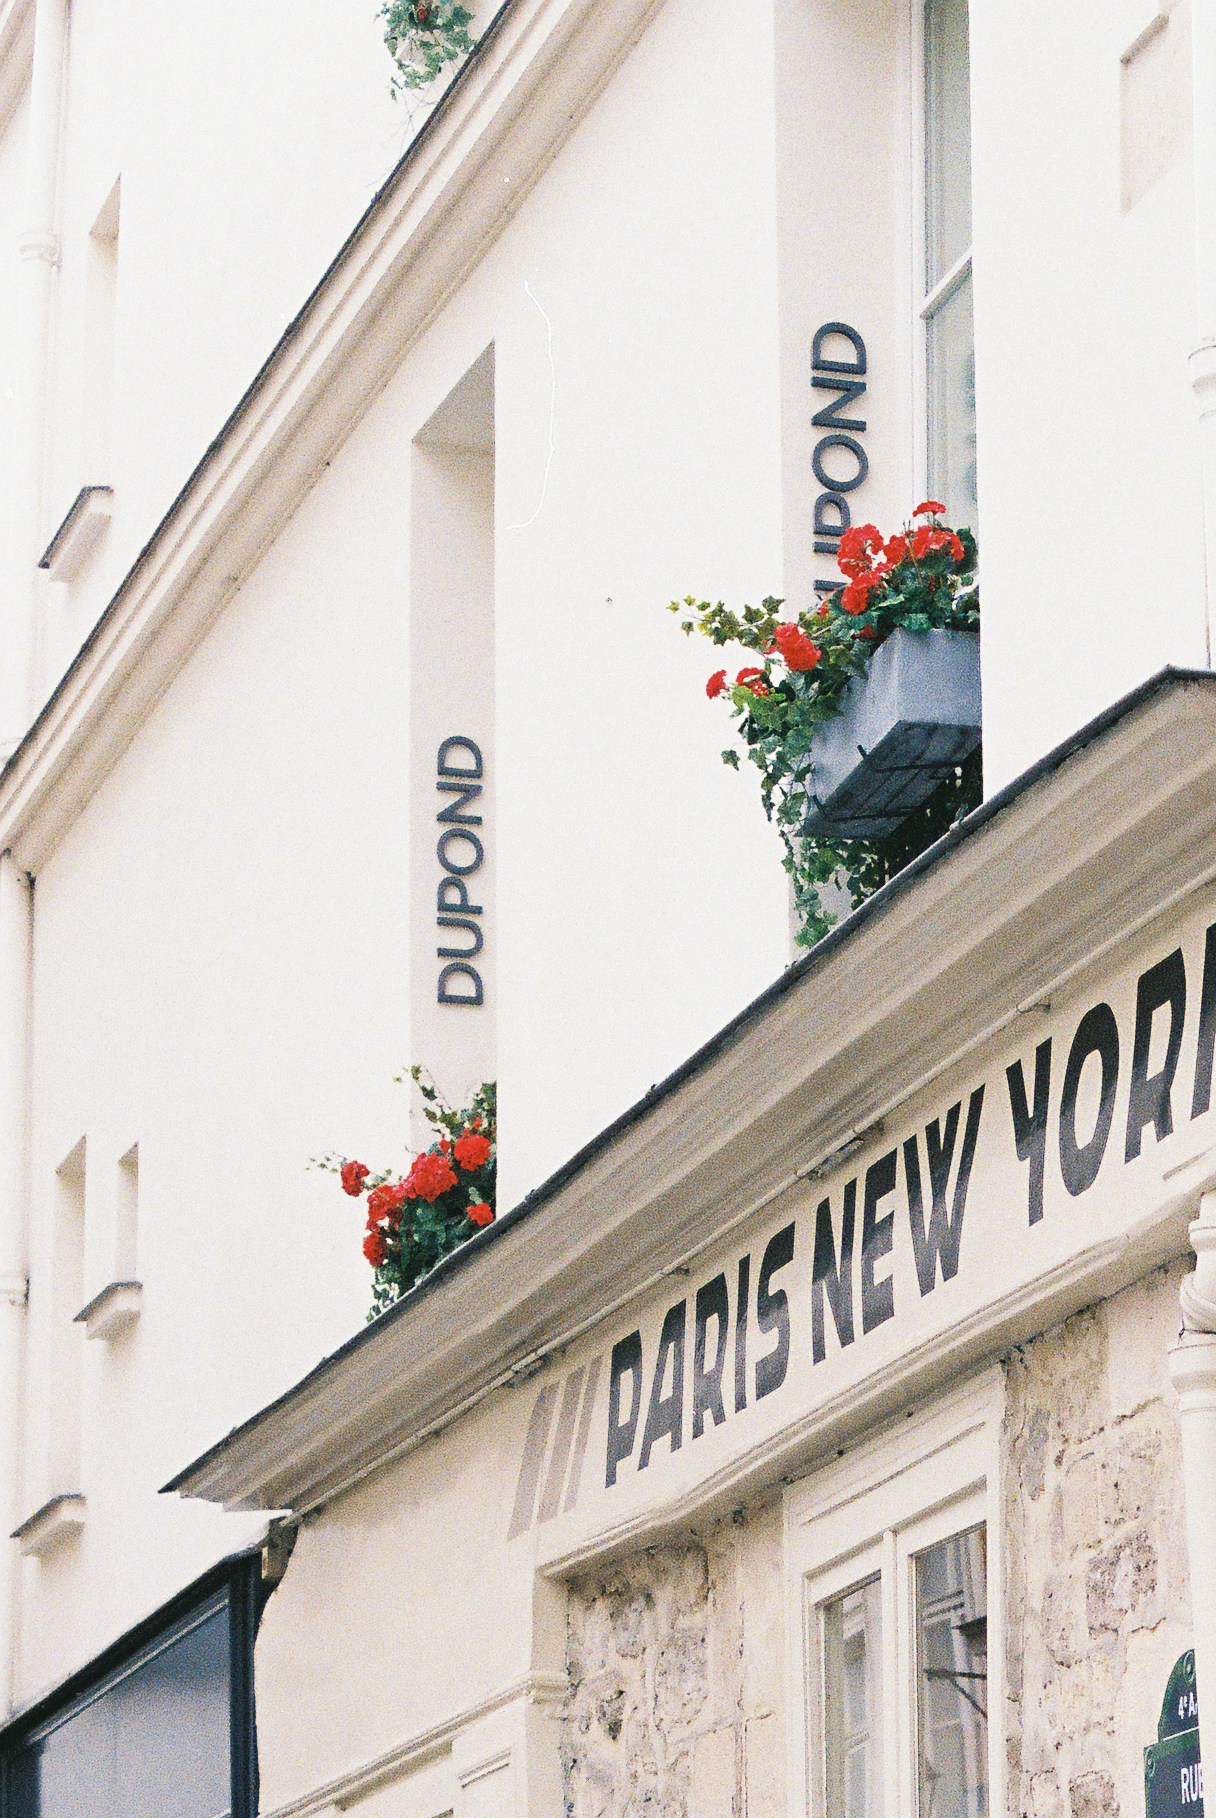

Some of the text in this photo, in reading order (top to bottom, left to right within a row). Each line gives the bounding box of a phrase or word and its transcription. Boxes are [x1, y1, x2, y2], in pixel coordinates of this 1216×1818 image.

[436, 735, 485, 1006] DUPOND
[605, 1220, 795, 1489] PARIS
[812, 1083, 987, 1366] NEW
